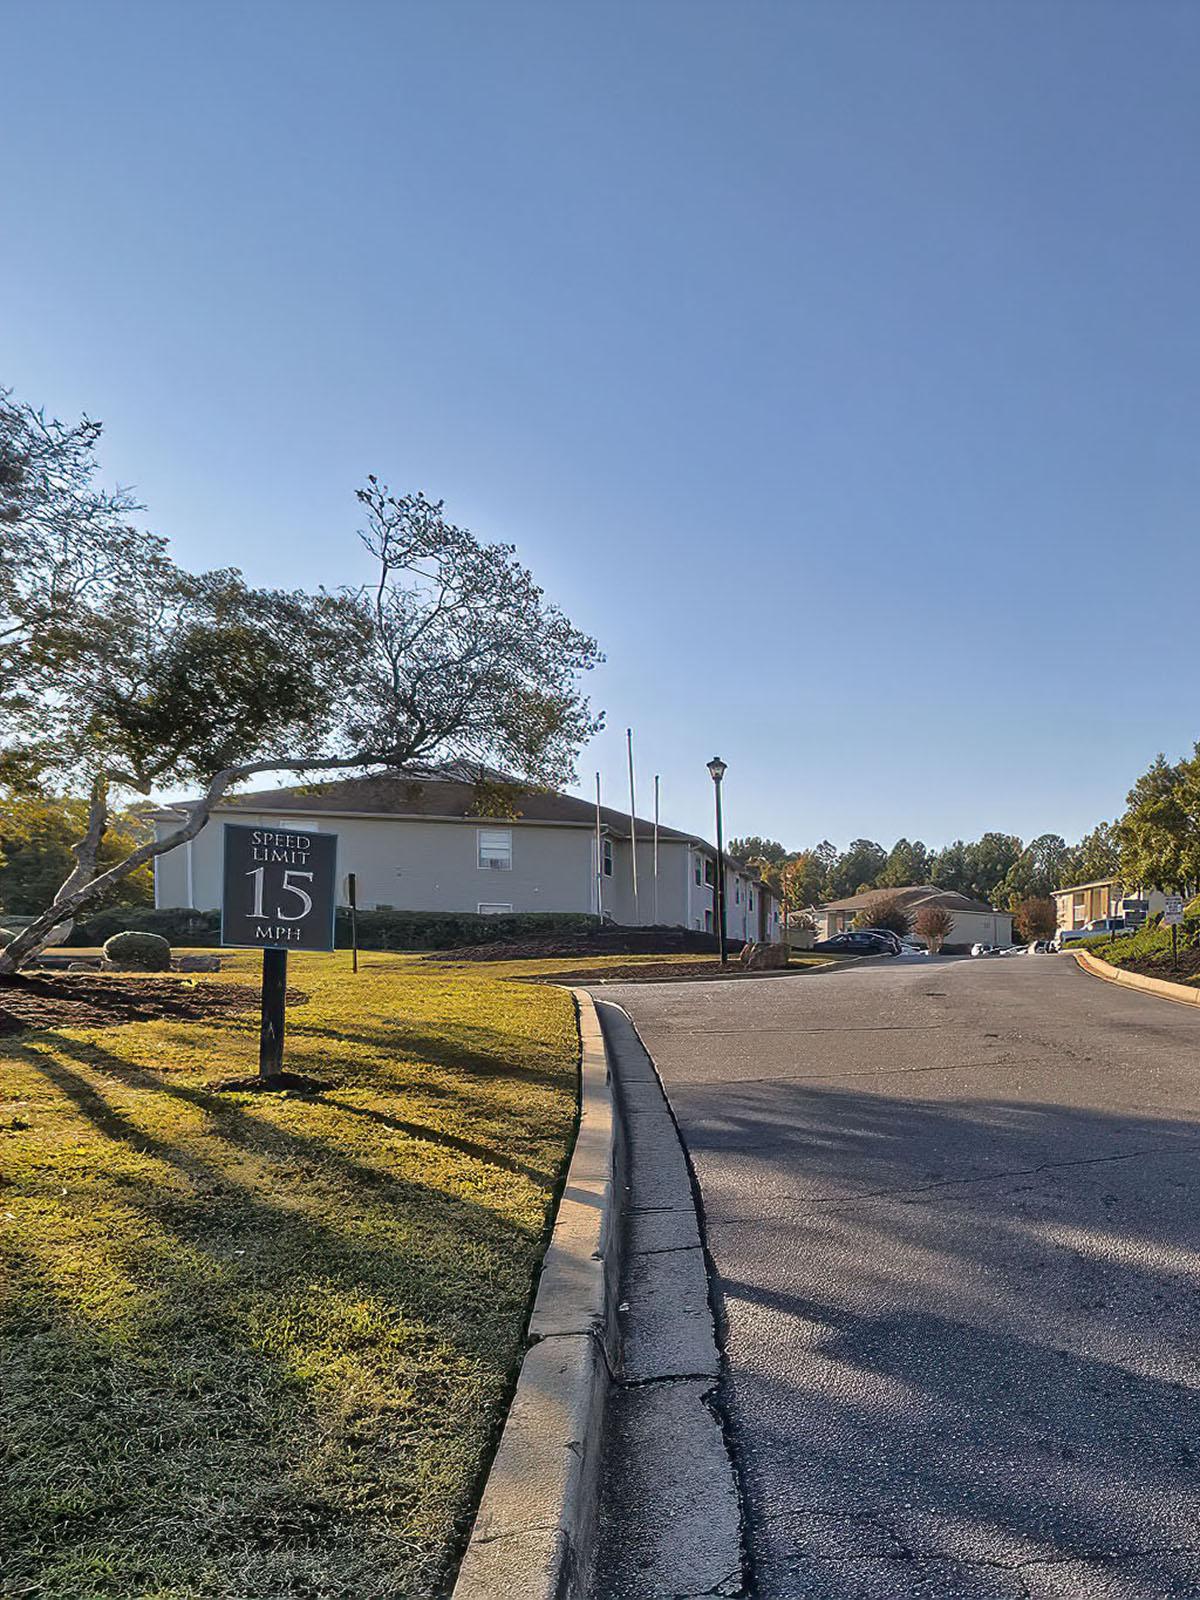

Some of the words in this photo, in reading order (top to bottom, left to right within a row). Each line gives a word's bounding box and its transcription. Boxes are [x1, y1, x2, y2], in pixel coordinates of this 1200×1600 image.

[252, 831, 311, 850] SPEED
[253, 847, 311, 865] LIMIT
[245, 866, 314, 921] 15
[256, 926, 301, 941] MPH
